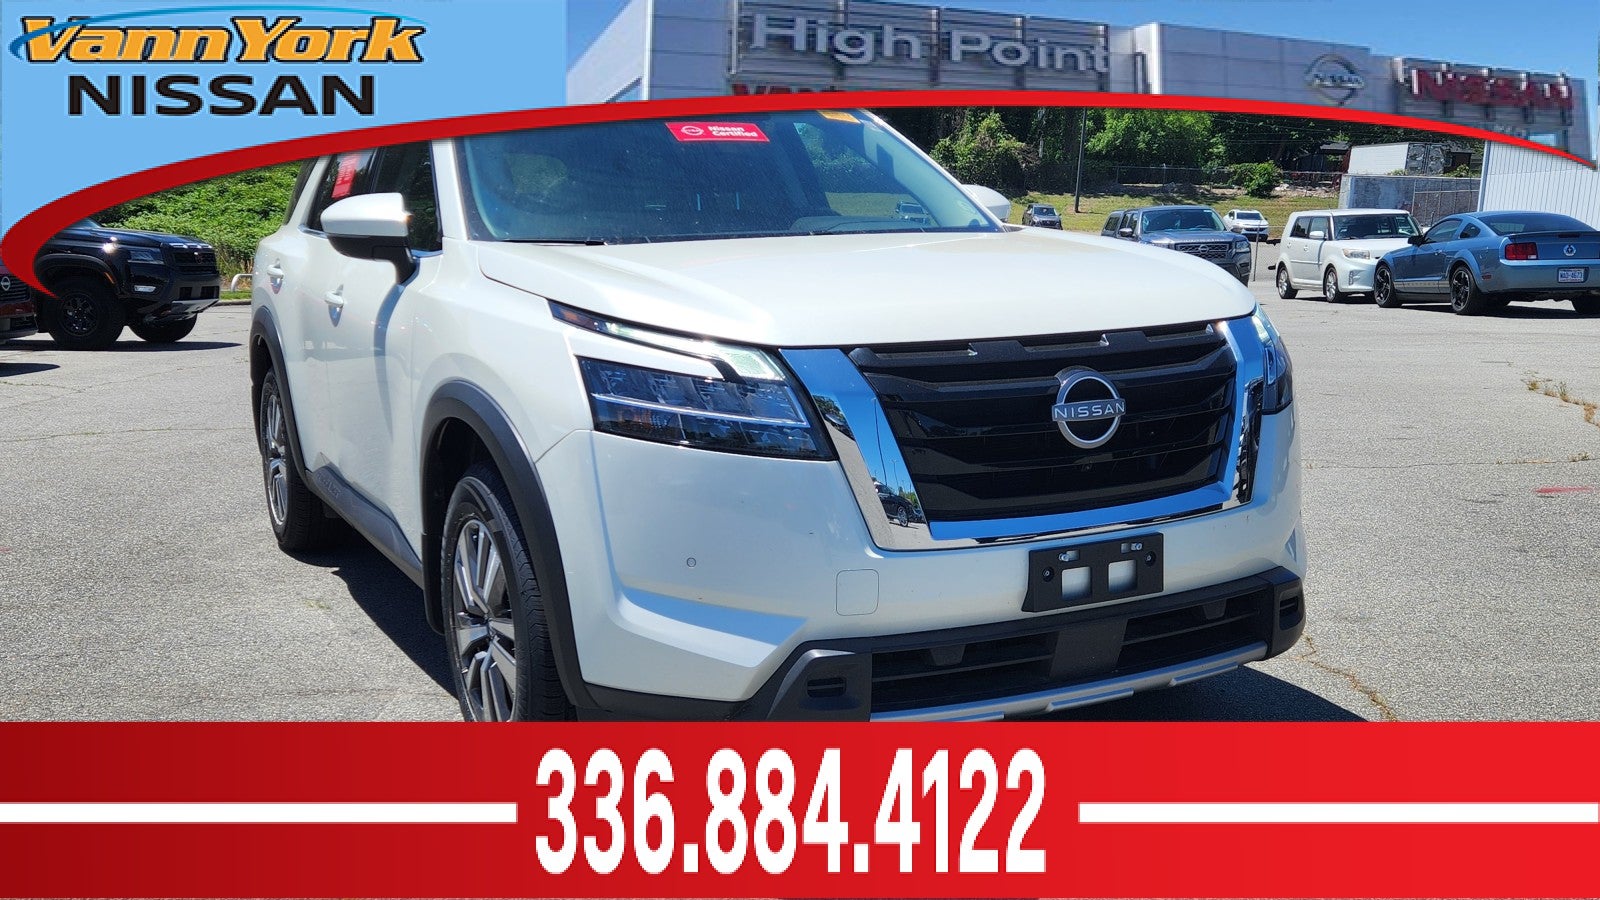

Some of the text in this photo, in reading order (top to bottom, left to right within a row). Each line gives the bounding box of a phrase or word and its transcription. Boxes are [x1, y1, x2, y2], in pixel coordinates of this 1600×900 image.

[751, 15, 1110, 73] High Point
[1055, 402, 1125, 419] NISSAN
